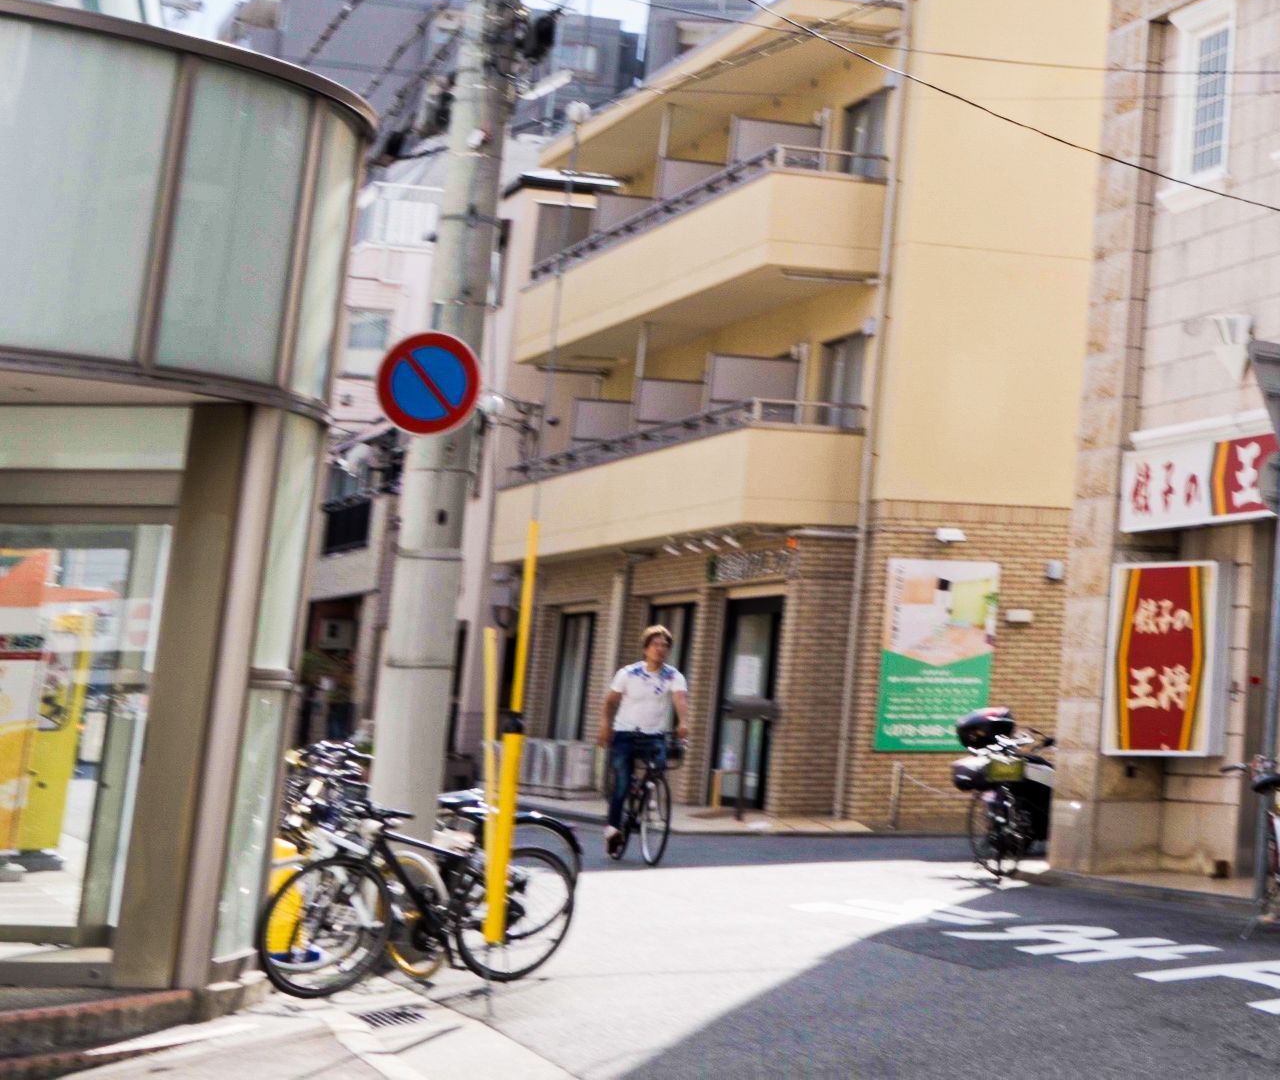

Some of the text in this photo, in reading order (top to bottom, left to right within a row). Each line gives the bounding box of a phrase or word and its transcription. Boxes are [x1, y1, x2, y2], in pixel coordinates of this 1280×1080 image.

[1133, 597, 1194, 635] 餃子の
[1127, 663, 1192, 713] 王将
